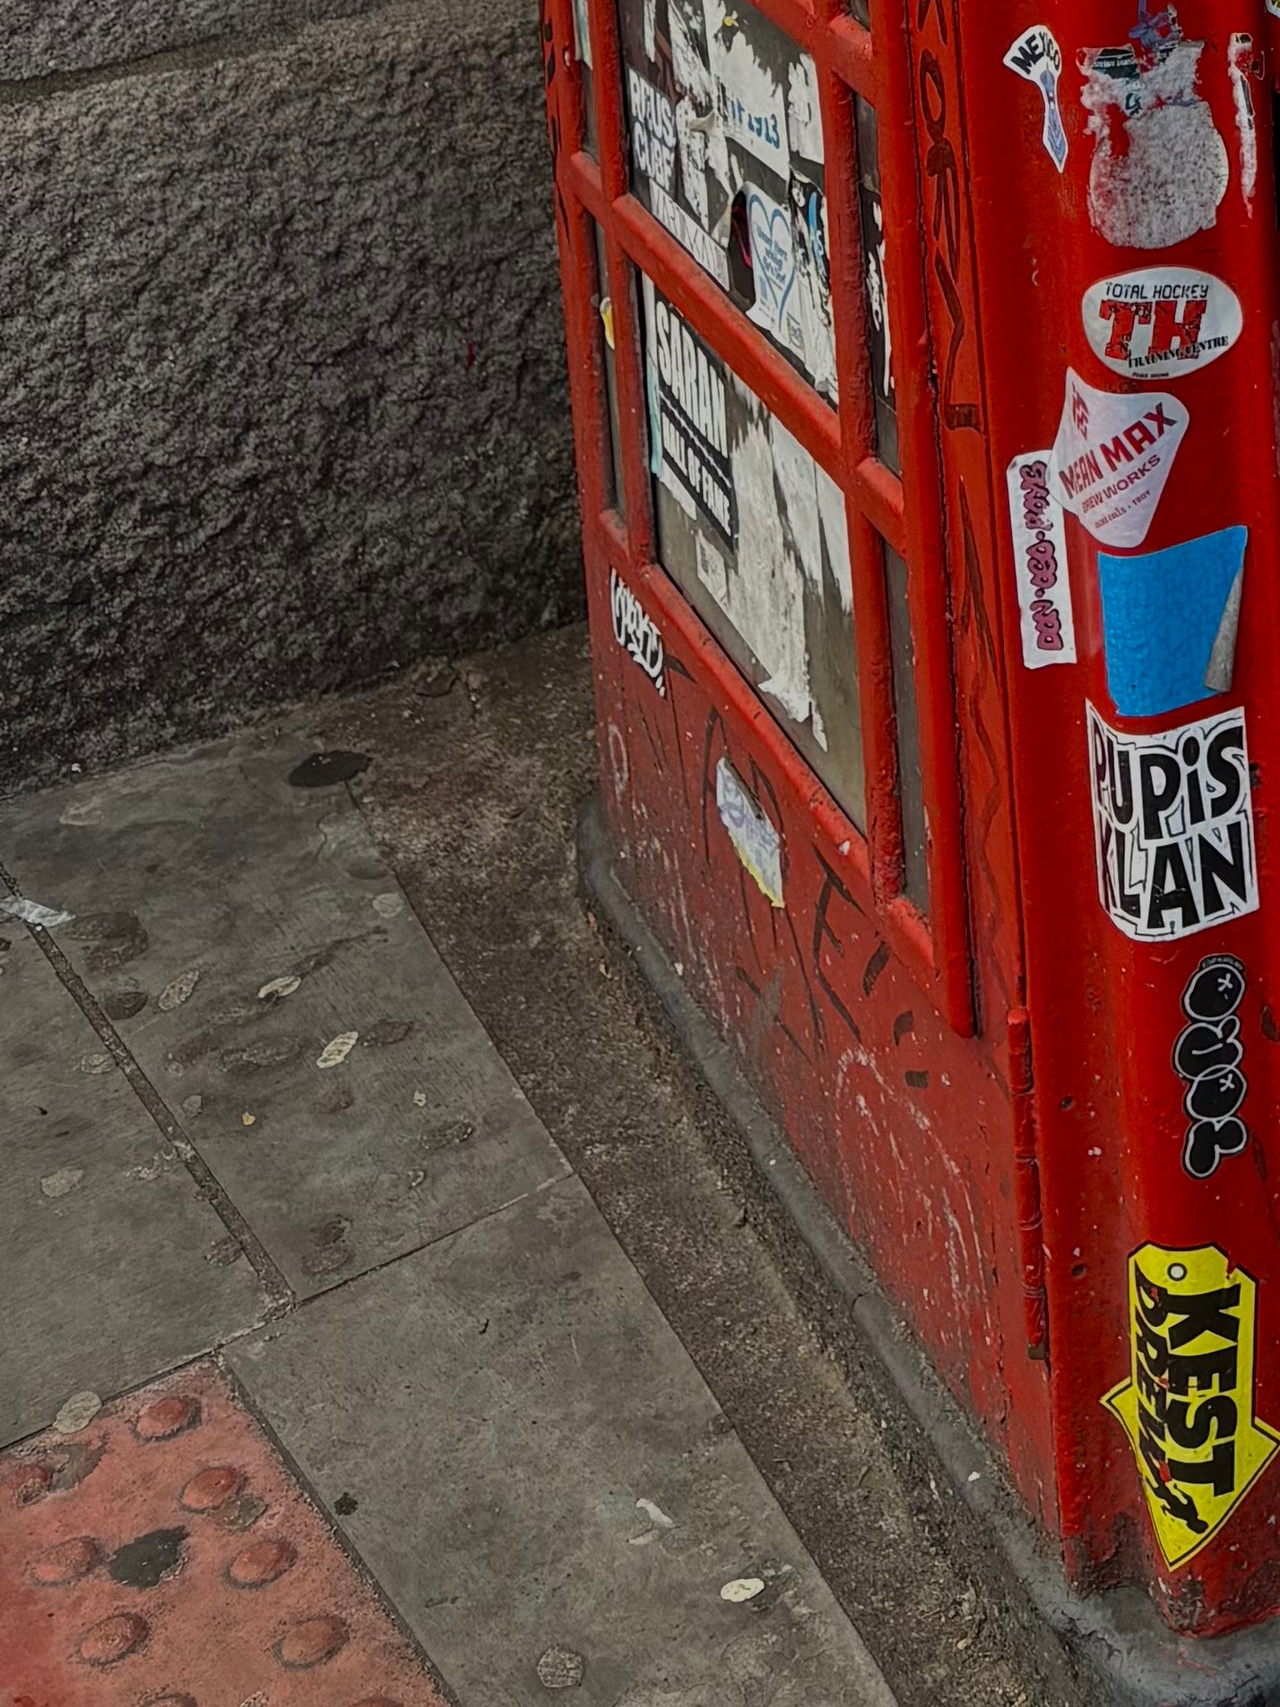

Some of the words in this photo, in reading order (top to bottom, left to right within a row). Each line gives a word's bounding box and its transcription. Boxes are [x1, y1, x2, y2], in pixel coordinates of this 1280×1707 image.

[1010, 29, 1062, 74] MEXICO
[1105, 281, 1148, 300] TOTAL
[1152, 283, 1209, 299] HOCKEY
[1060, 448, 1101, 500] MEAN
[1099, 402, 1178, 473] MAX
[1096, 823, 1252, 933] KLAN
[1163, 1280, 1244, 1498] KEST
